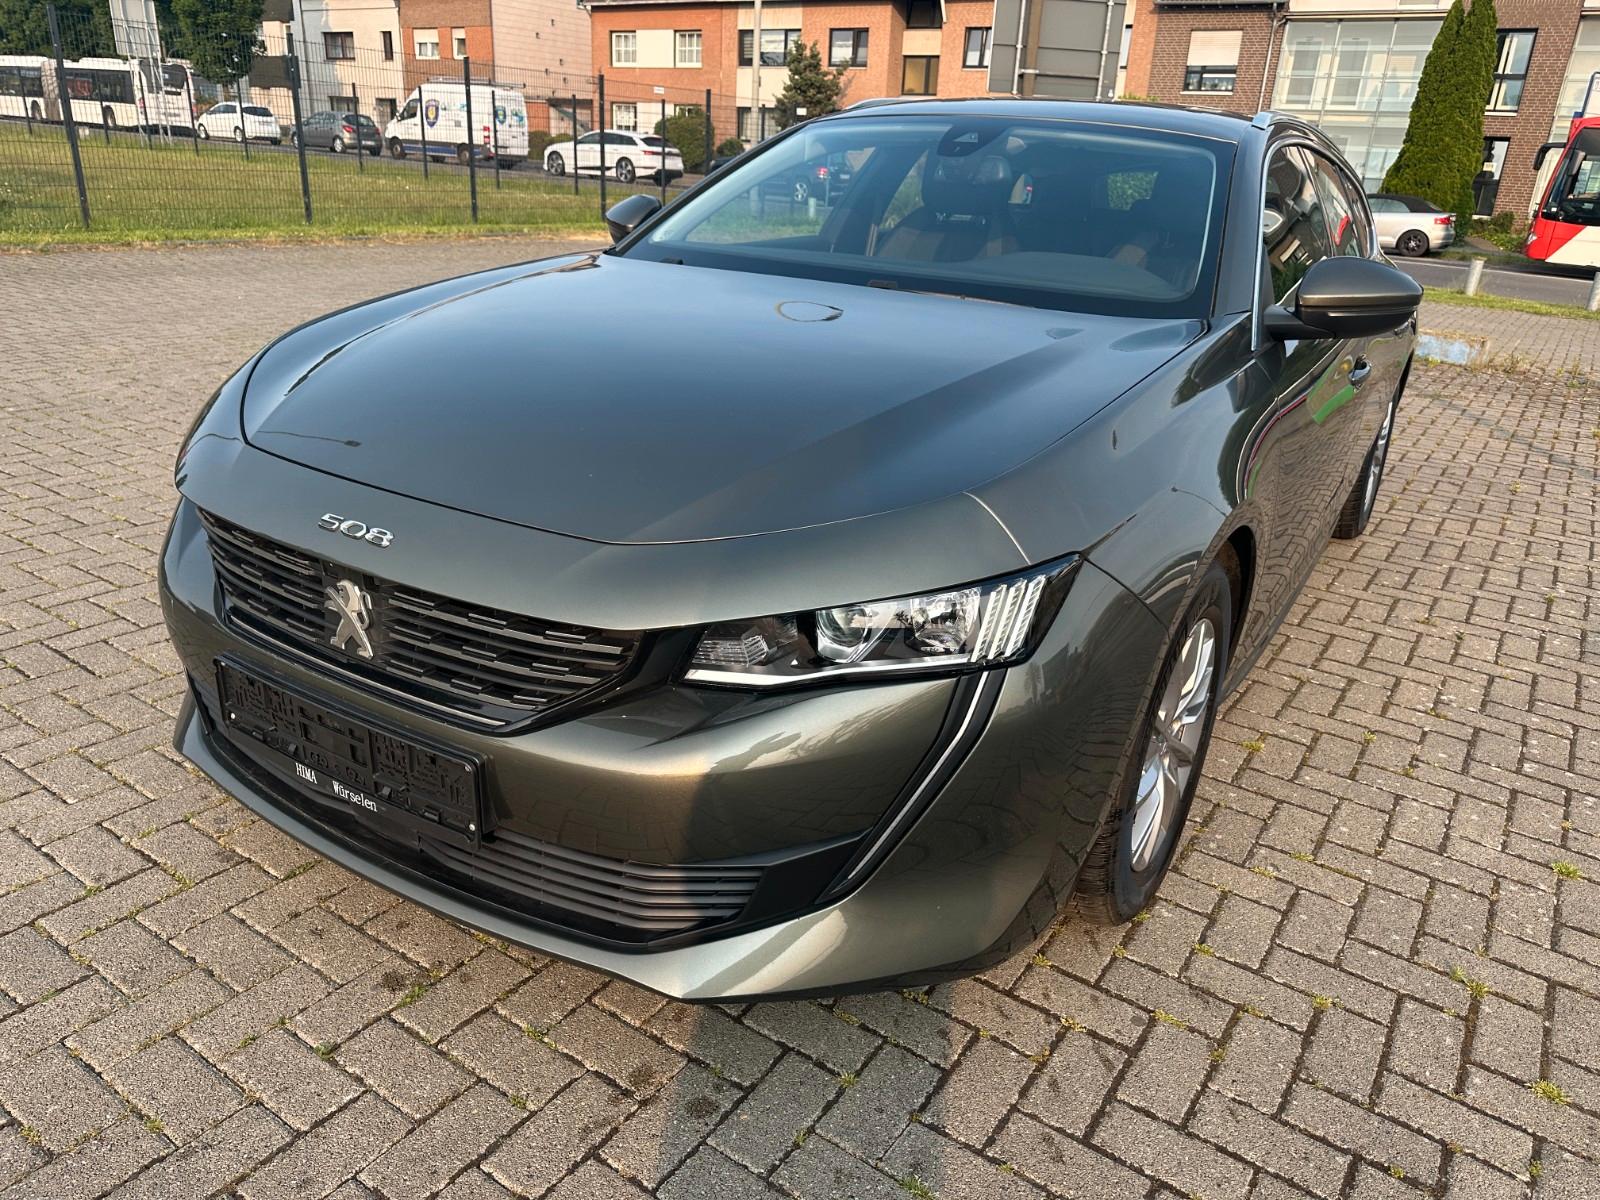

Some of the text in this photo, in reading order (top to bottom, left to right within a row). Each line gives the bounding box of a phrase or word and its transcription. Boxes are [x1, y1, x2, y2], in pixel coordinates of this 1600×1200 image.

[318, 513, 394, 548] 508
[295, 762, 378, 813] HIMA Würselen
